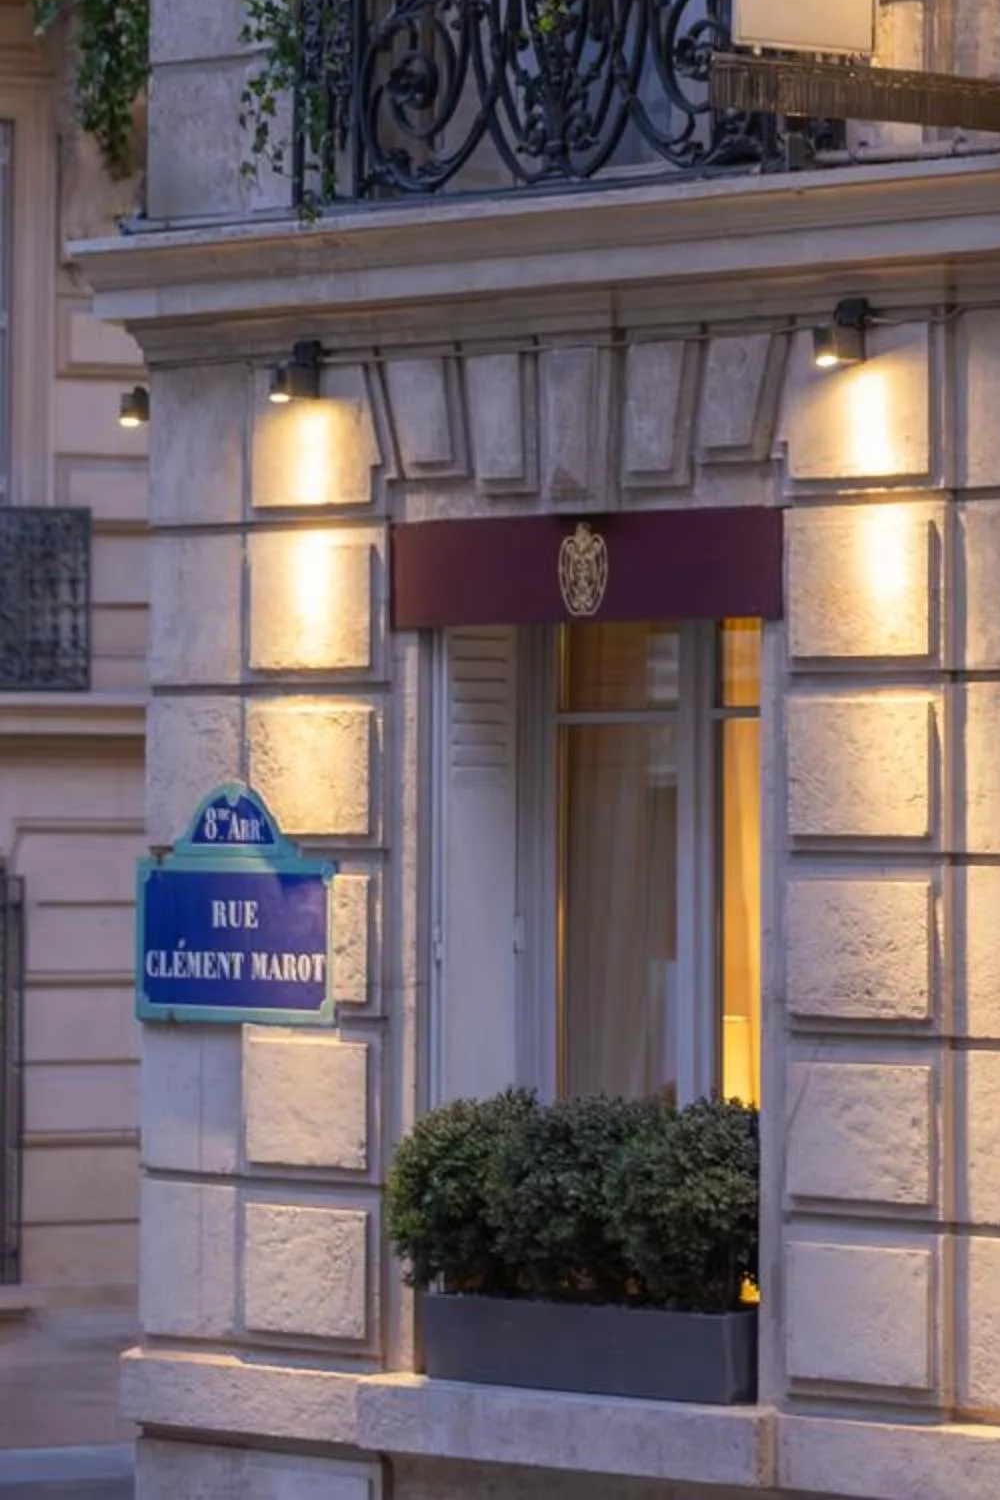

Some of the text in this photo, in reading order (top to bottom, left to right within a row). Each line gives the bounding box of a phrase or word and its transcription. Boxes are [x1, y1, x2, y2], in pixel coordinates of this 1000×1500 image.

[212, 900, 259, 928] RUE
[146, 938, 326, 982] CLÉMENT MAROT
